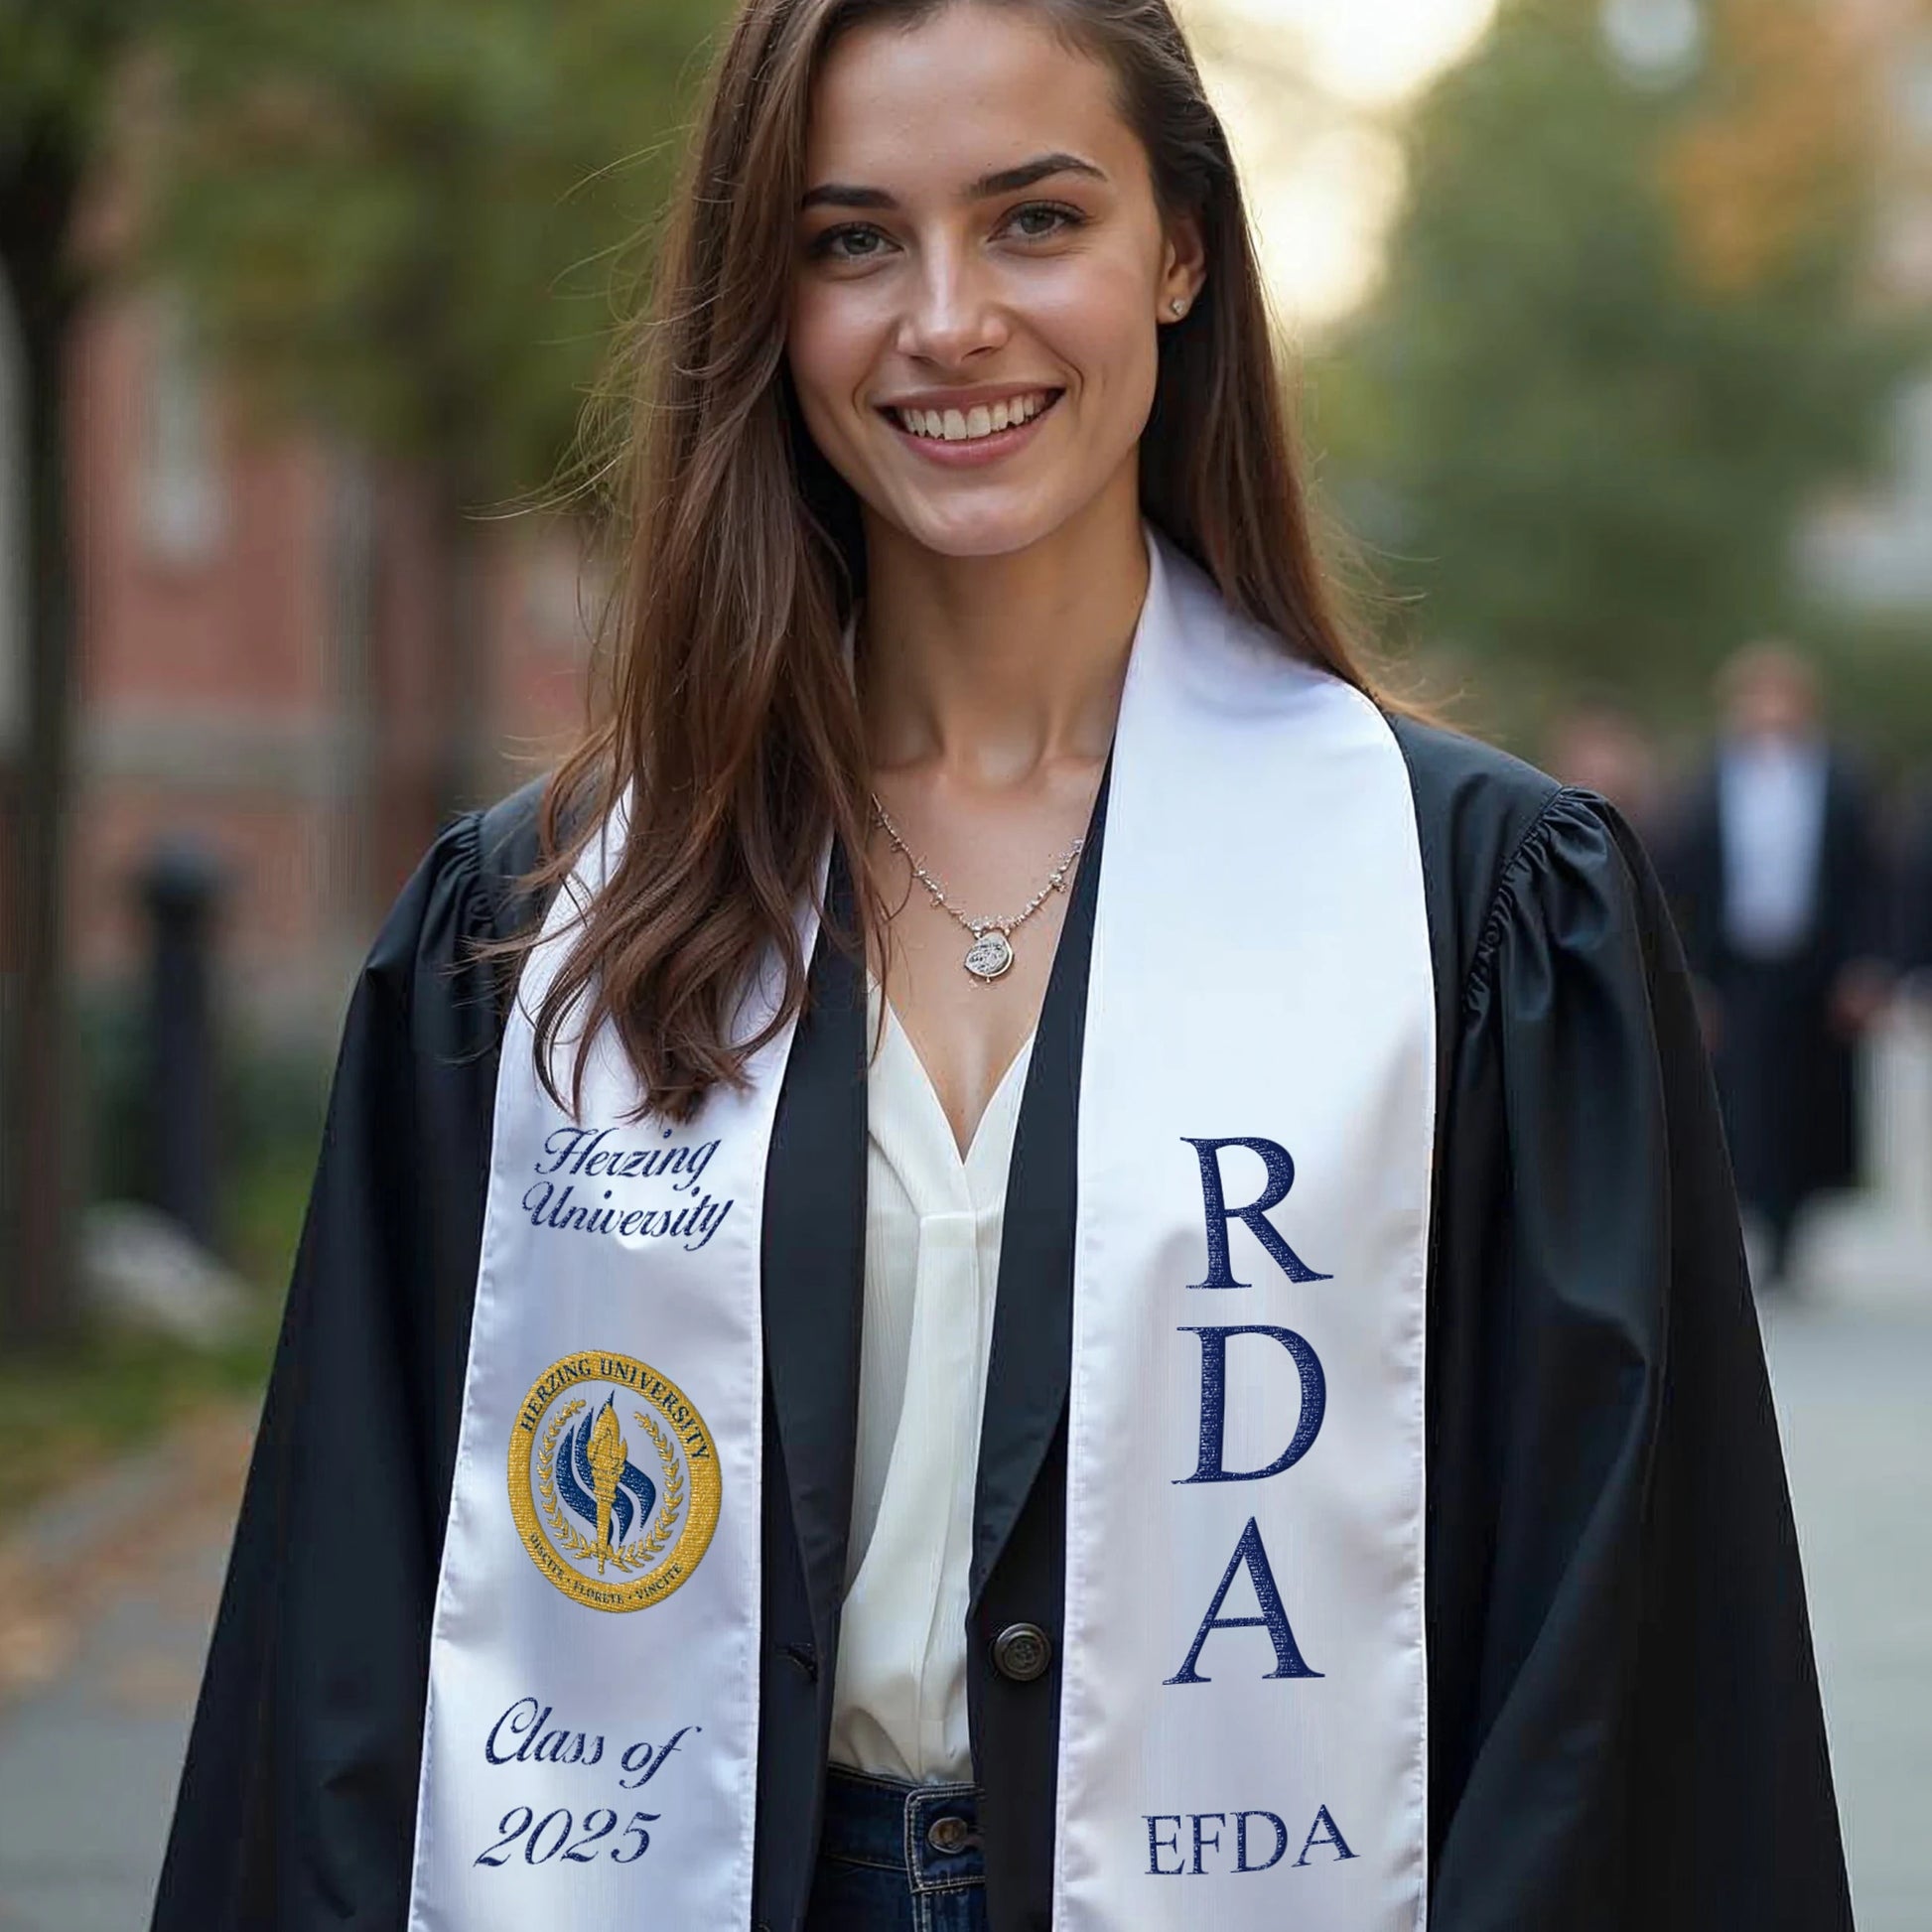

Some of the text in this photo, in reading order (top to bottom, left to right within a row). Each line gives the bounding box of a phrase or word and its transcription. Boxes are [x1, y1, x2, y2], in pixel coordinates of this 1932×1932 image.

[534, 1127, 722, 1191] Herzing
[521, 1180, 735, 1252] University
[519, 1357, 711, 1460] HERZING UNIVERSITY
[634, 1563, 683, 1601] VINCITE
[484, 1696, 703, 1790] Class of
[473, 1805, 661, 1868] 2025
[1142, 1804, 1360, 1875] EFDA
